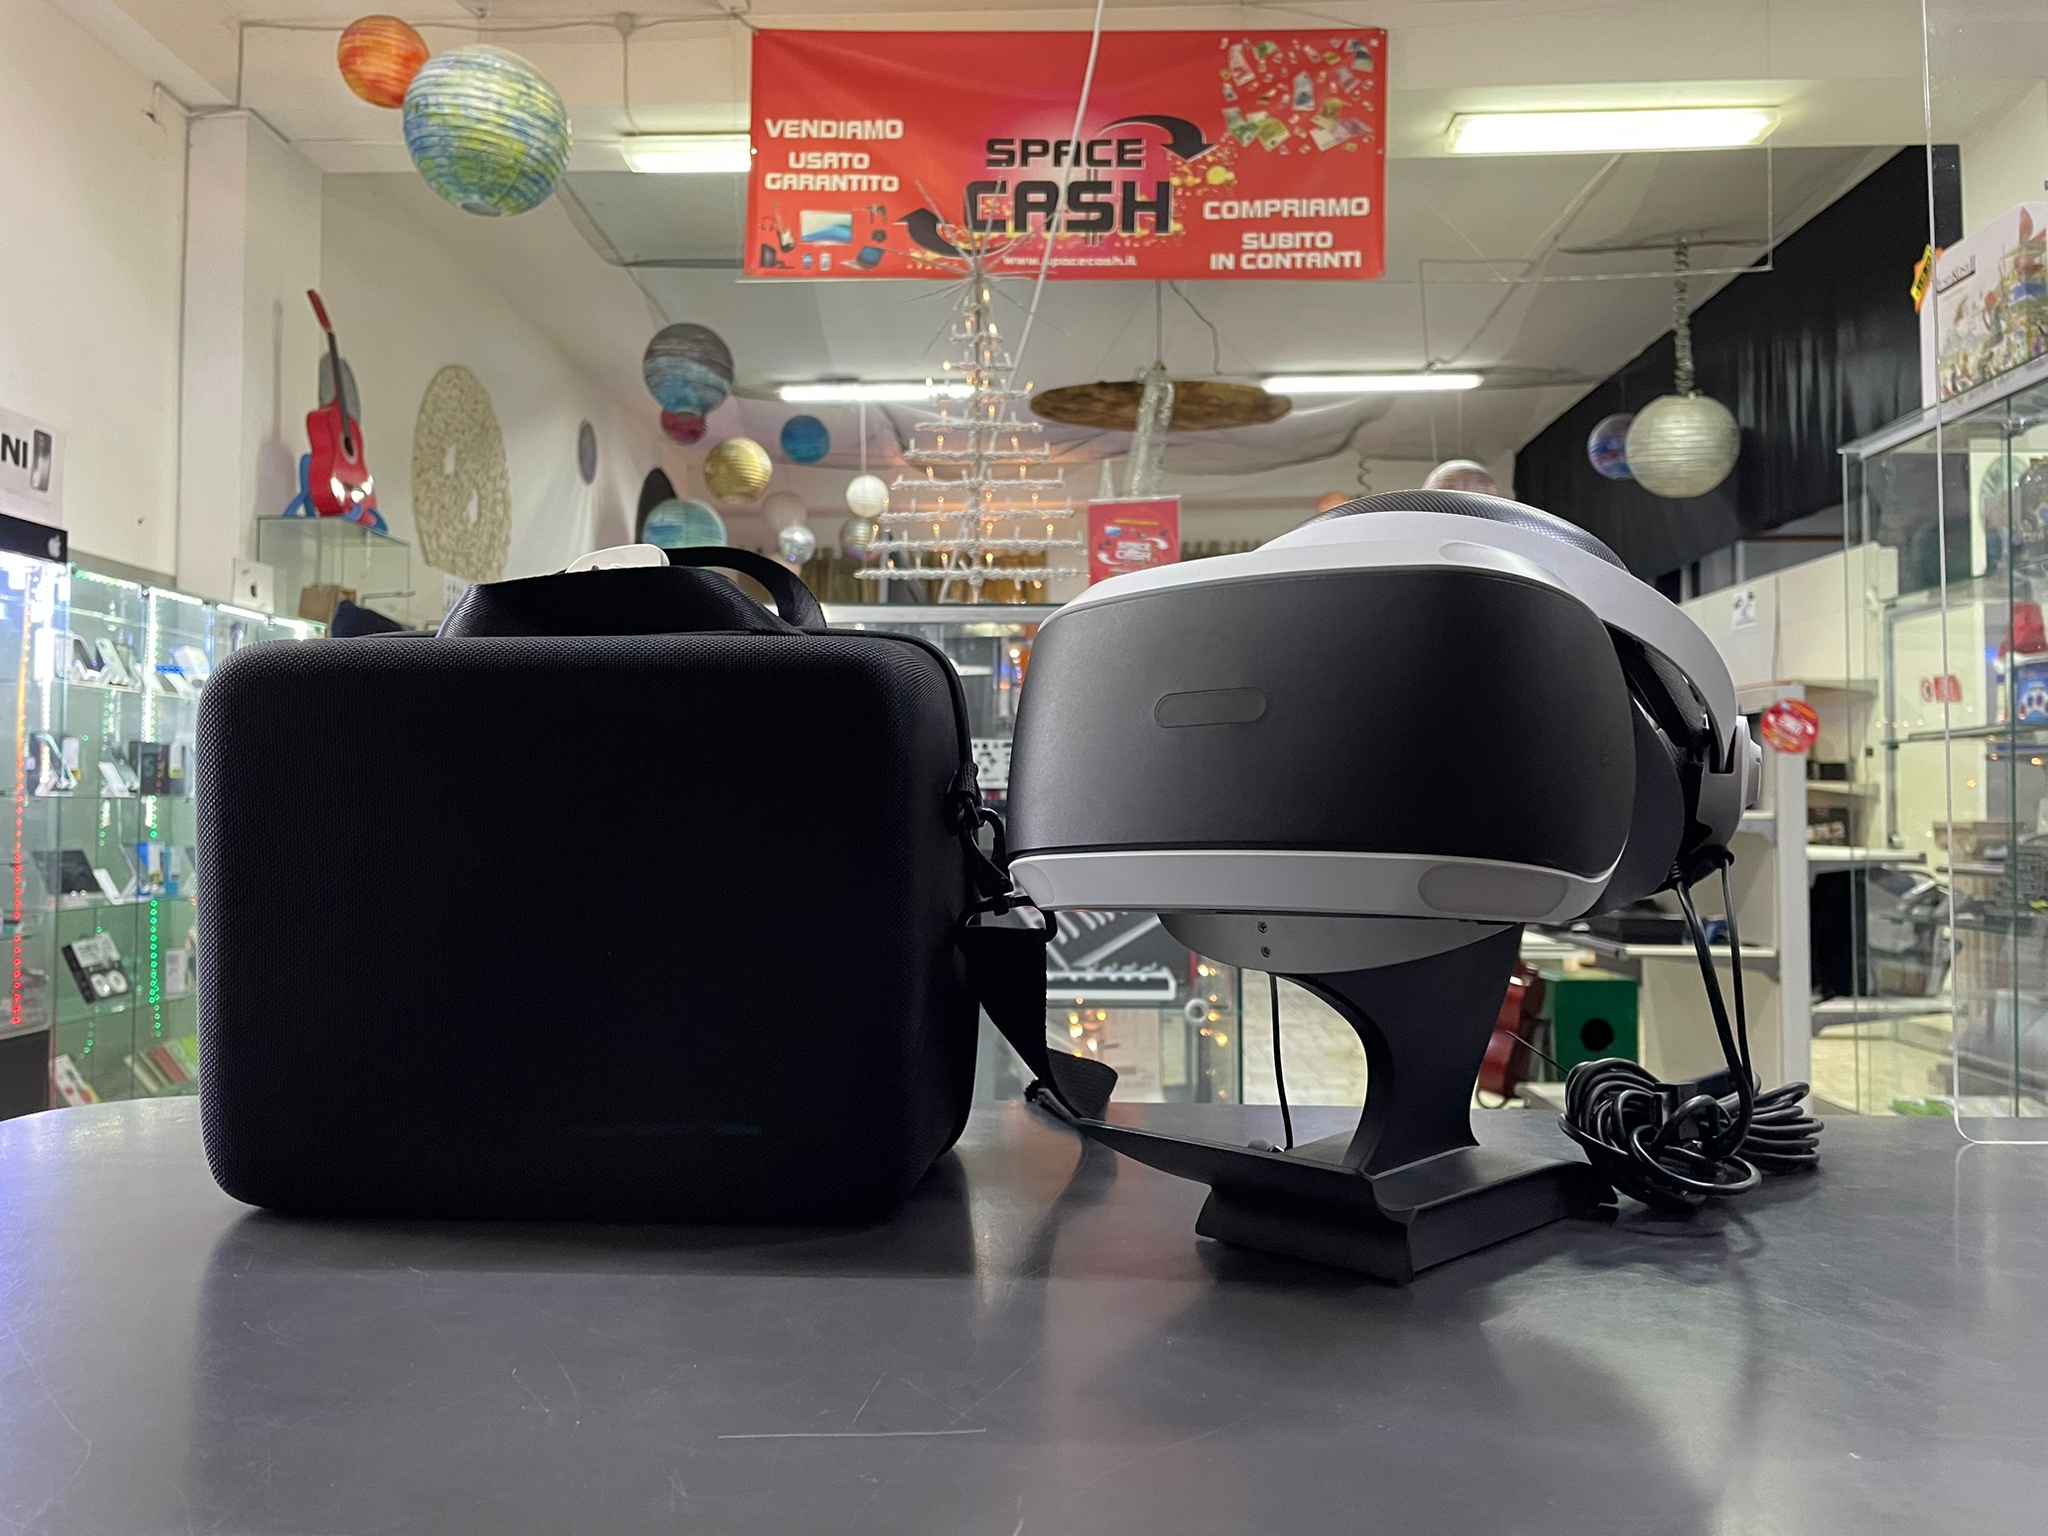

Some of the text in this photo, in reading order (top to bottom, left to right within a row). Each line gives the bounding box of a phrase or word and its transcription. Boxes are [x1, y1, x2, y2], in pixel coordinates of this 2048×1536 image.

[764, 118, 904, 140] VENDIAMO
[788, 151, 870, 170] USATO
[986, 138, 1145, 169] SPACE
[764, 172, 900, 192] GARANTITO
[965, 180, 1171, 234] CASH
[1203, 196, 1371, 220] COMPRIAMO
[1241, 231, 1333, 250] SUBITO
[1210, 251, 1362, 270] IN CONTANTI
